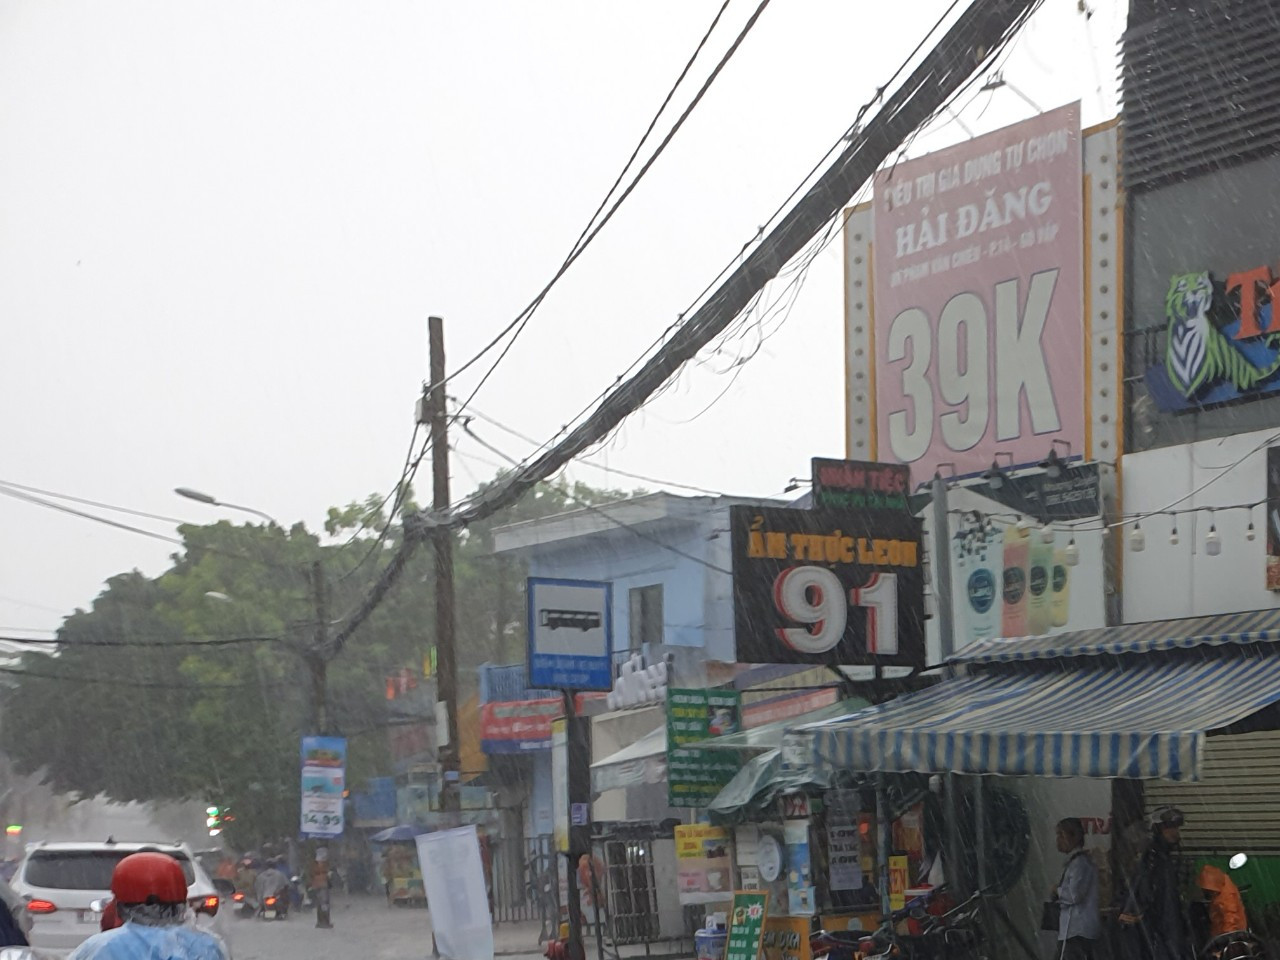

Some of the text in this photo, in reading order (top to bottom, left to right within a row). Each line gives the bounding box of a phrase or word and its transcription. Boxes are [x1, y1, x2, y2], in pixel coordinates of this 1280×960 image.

[896, 182, 1052, 258] HẢI ĐĂNG
[886, 268, 1063, 464] 39K
[773, 565, 899, 655] 91
